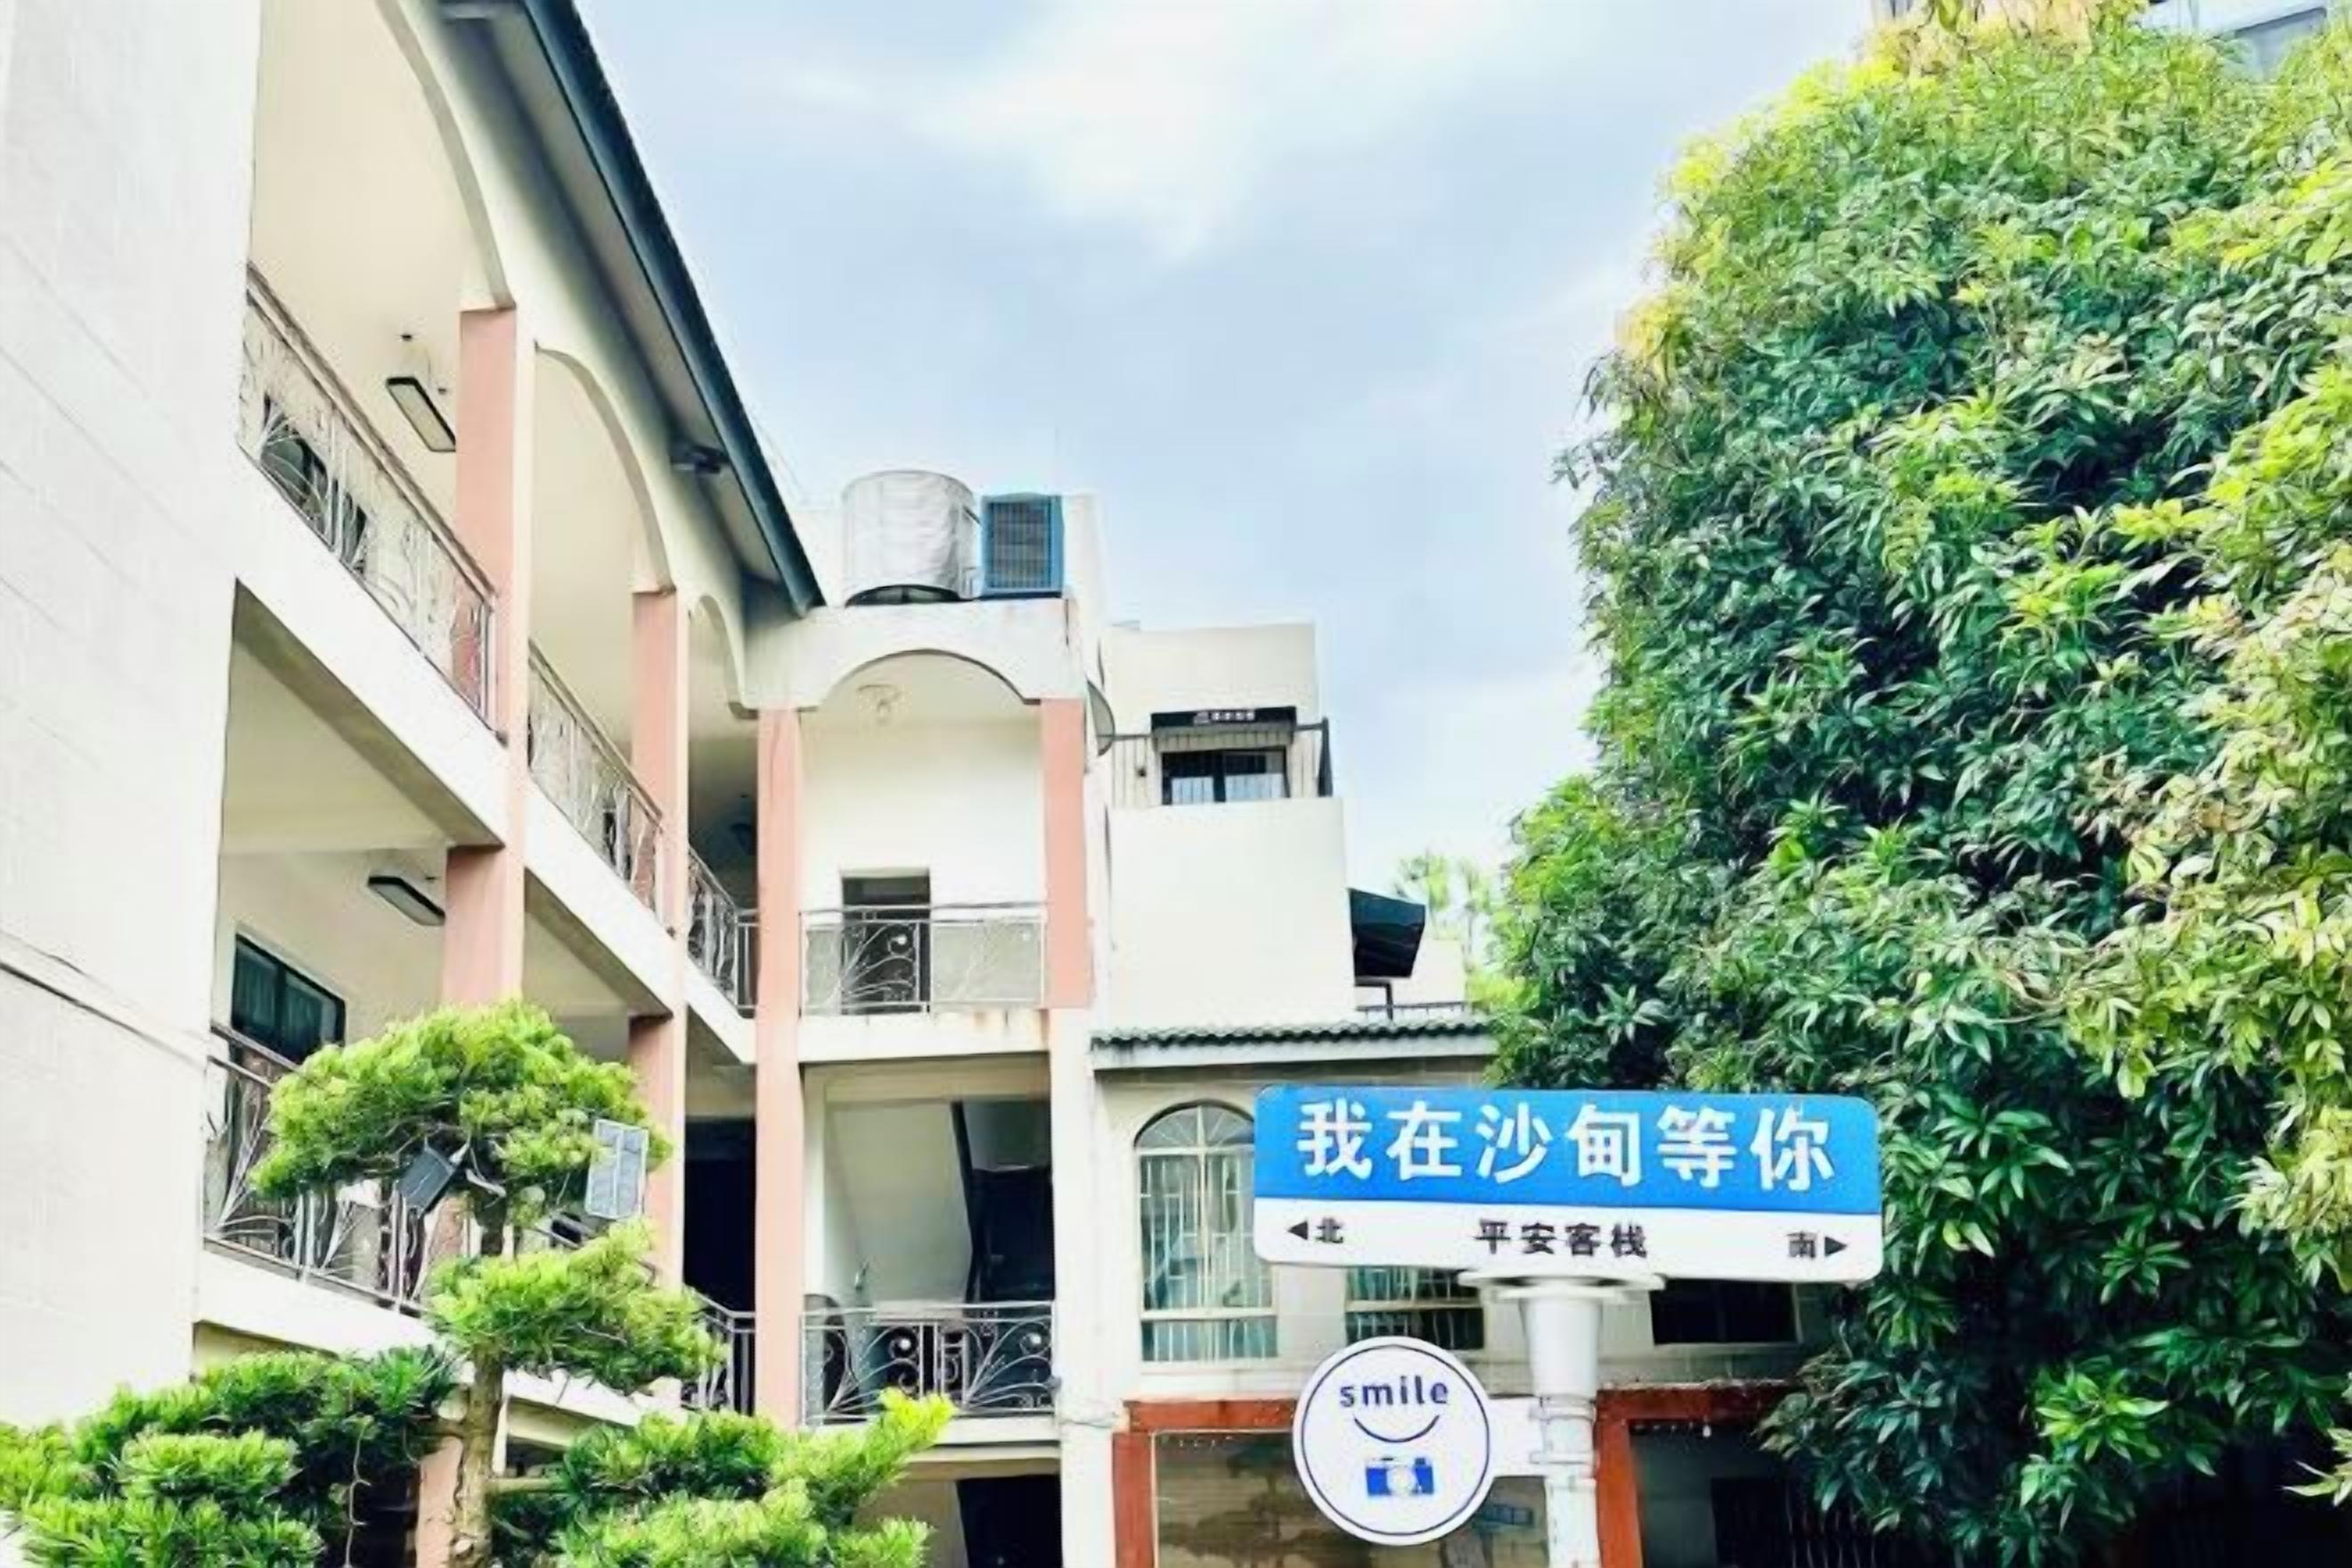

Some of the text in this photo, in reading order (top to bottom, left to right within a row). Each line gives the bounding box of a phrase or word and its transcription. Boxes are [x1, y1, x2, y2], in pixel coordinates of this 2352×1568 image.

[1296, 1097, 1835, 1192] 我在沙甸等你
[1315, 1217, 1344, 1245] 北
[1474, 1219, 1648, 1259] 平安客栈
[1788, 1231, 1818, 1259] 南
[1339, 1375, 1449, 1408] smile
